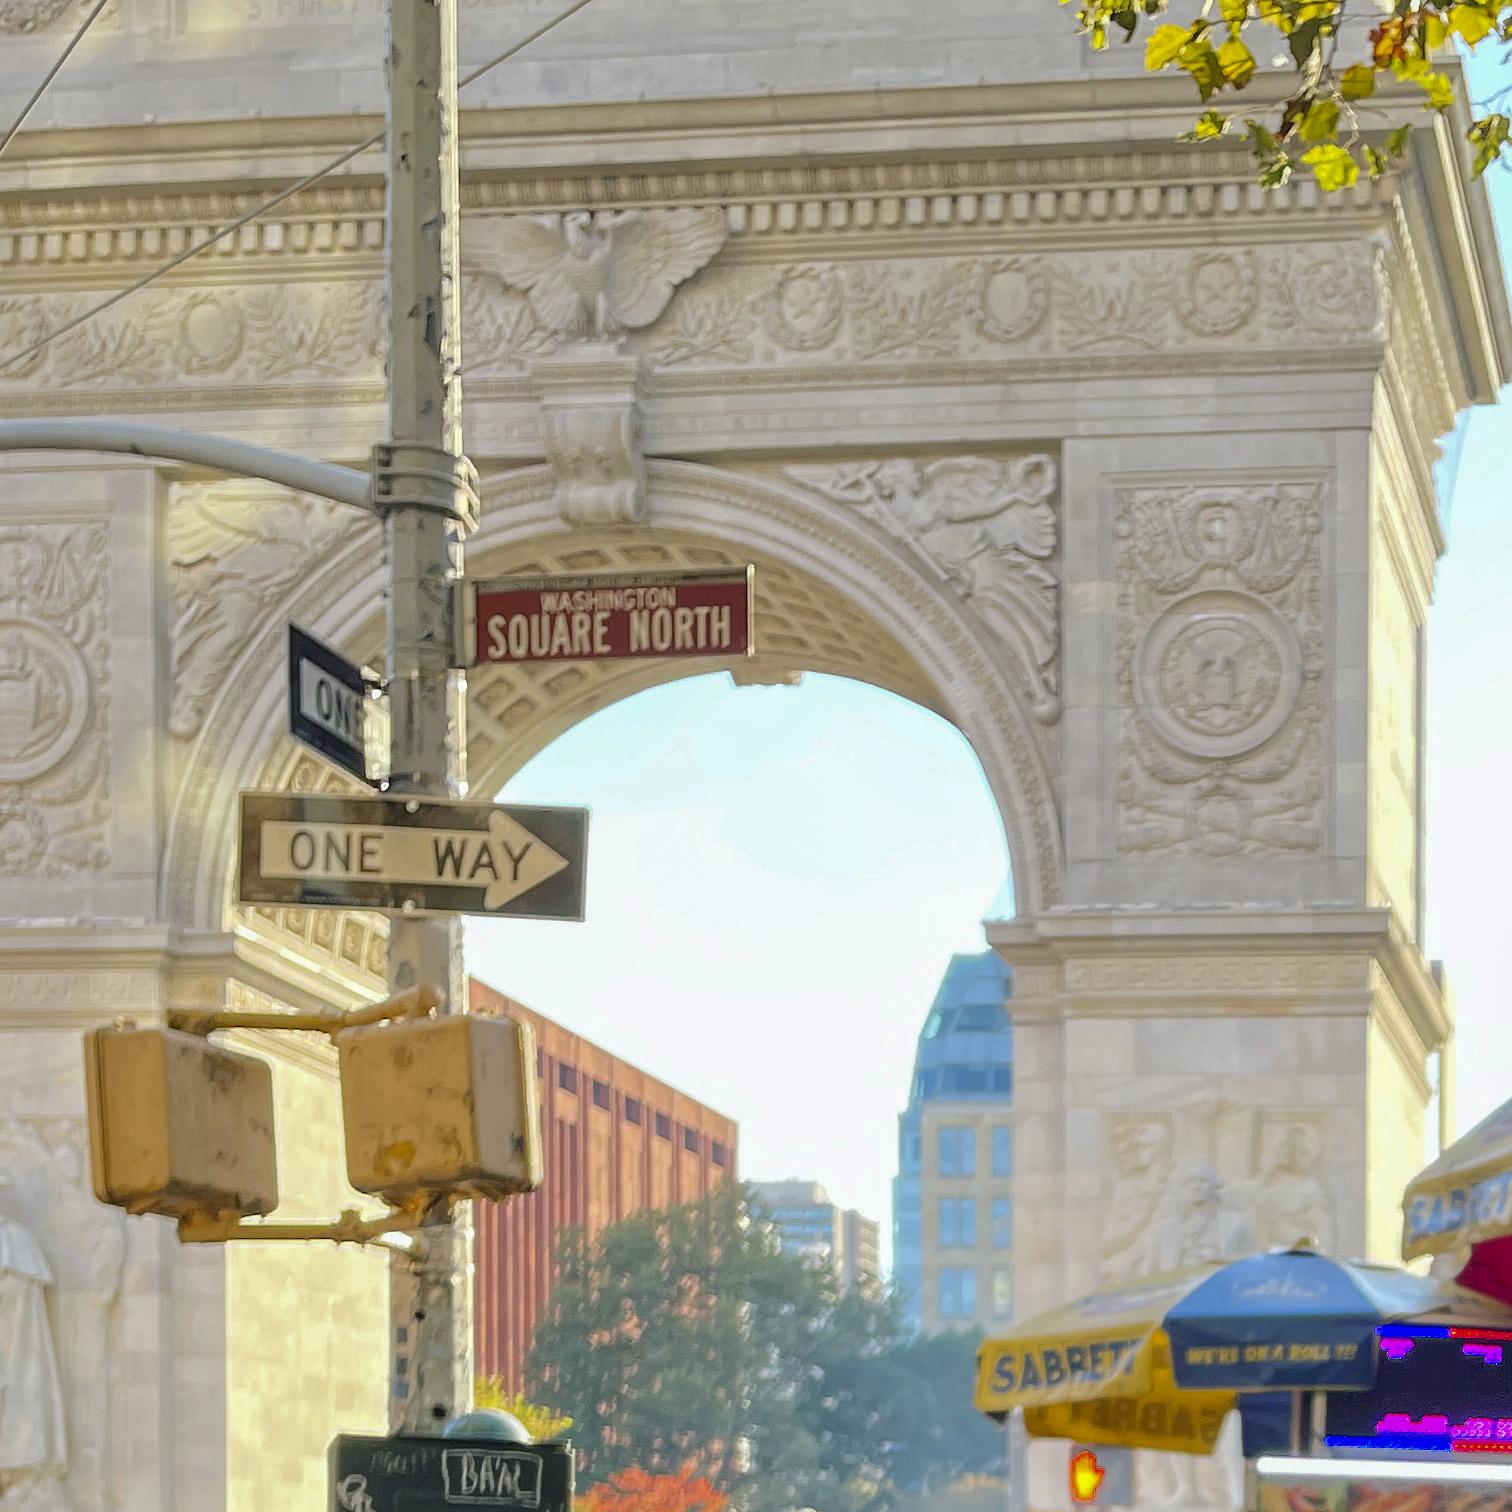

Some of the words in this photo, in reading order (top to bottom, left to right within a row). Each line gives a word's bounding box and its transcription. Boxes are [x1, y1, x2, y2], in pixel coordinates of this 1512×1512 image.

[540, 586, 677, 613] WASHINGTON
[487, 610, 613, 660] SQUARE
[629, 605, 731, 652] NORTH
[289, 831, 385, 874] ONE
[433, 837, 533, 881] WAY
